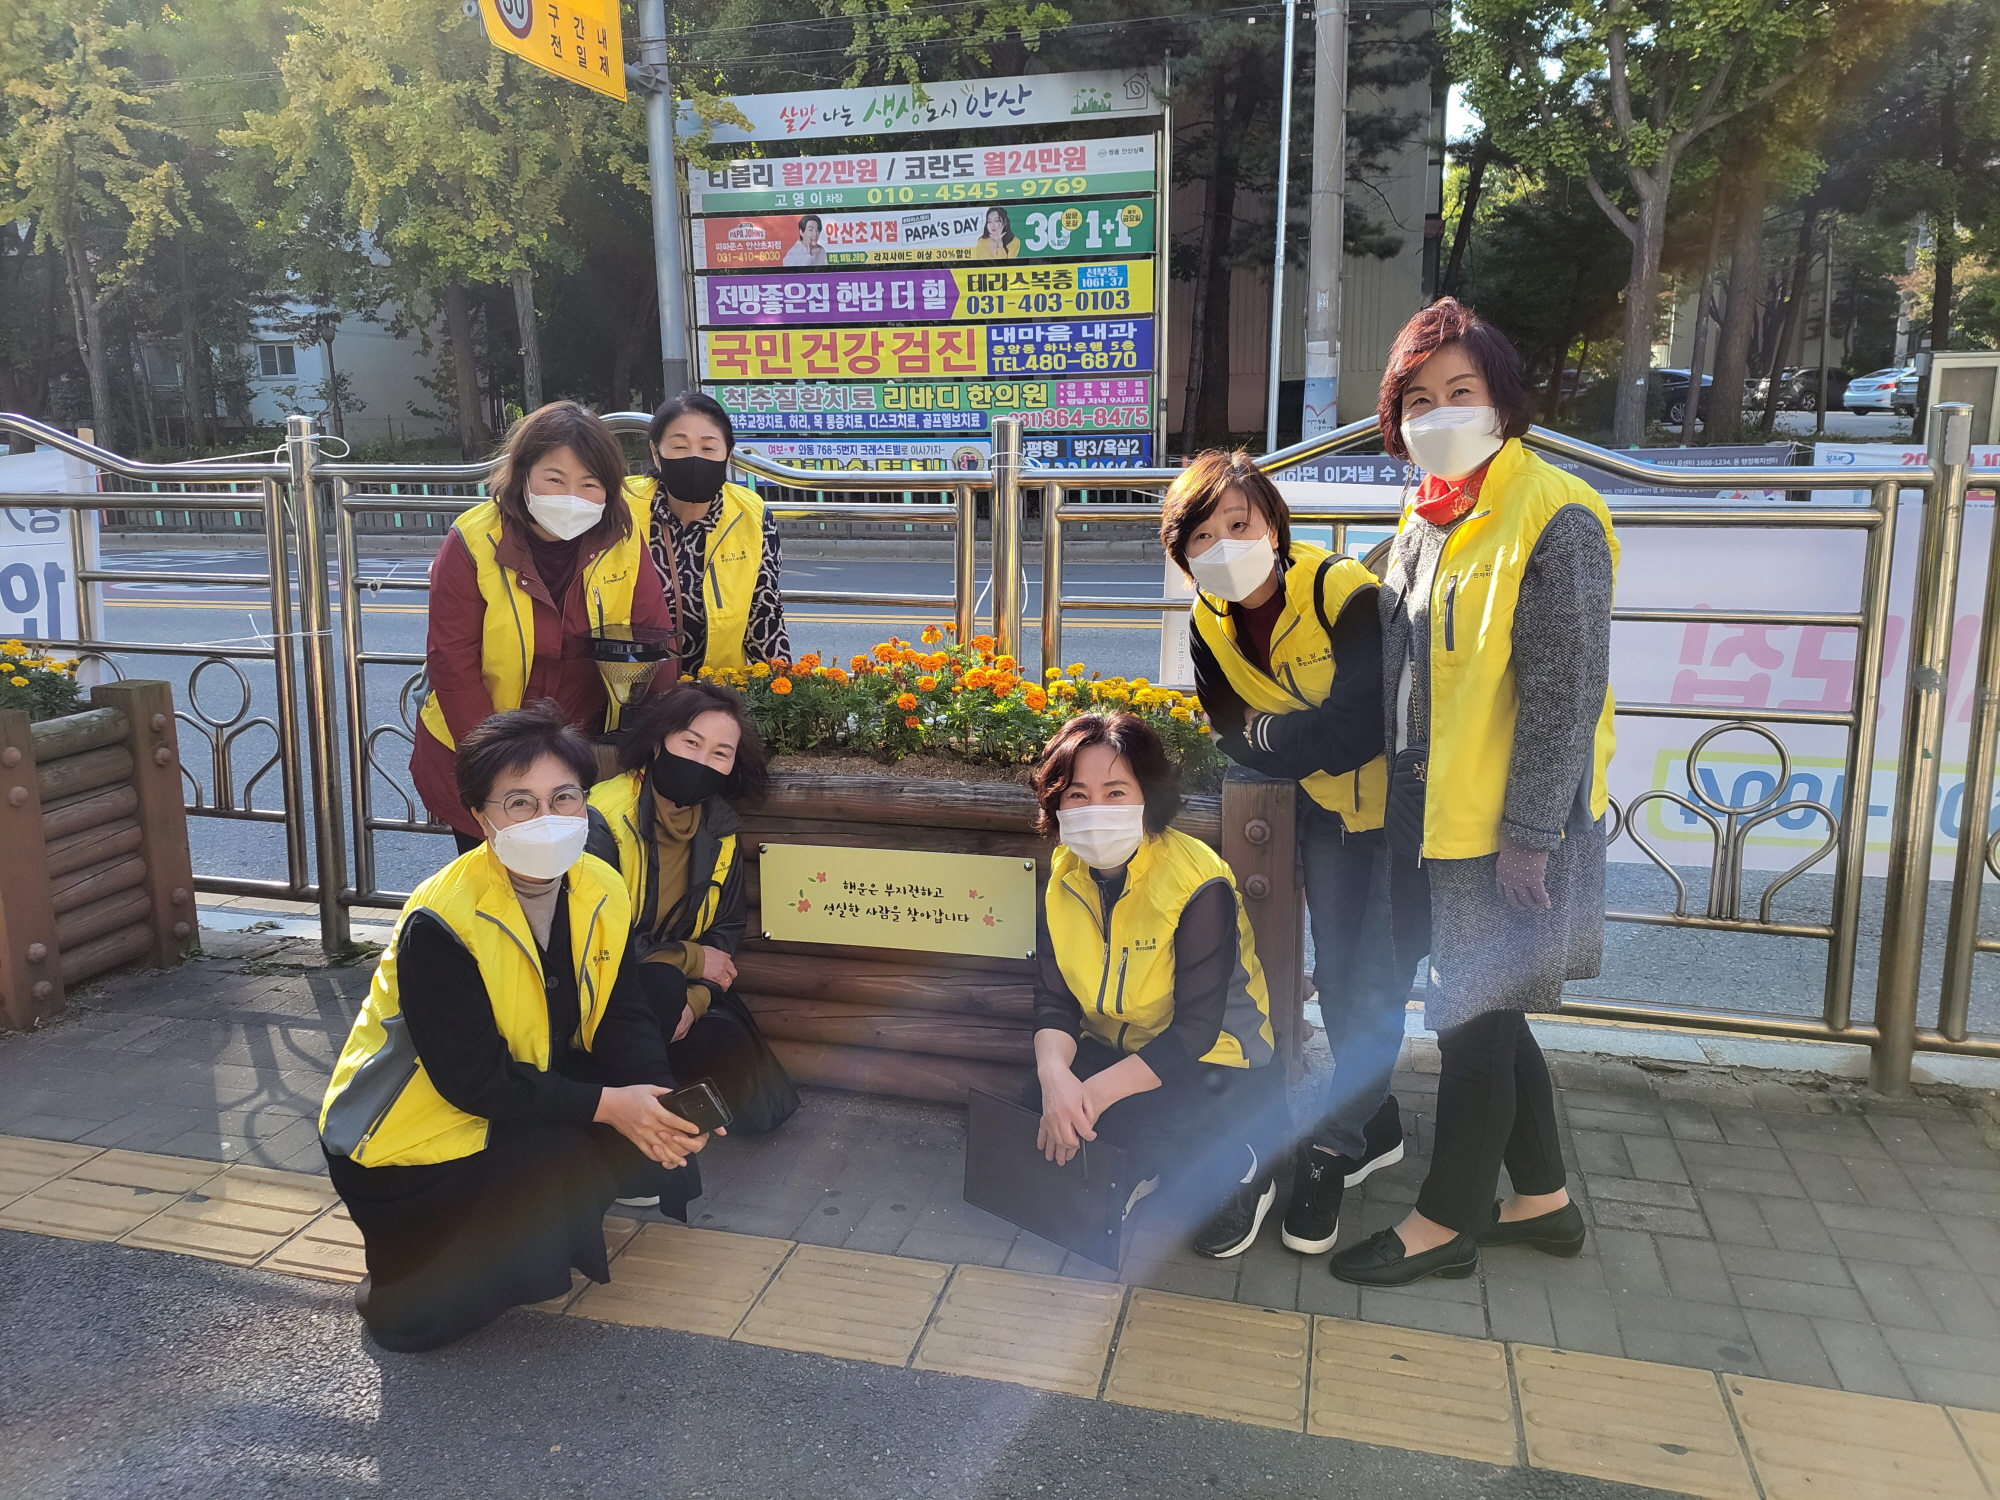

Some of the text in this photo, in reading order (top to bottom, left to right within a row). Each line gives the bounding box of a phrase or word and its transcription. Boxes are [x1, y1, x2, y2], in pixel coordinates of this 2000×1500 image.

[965, 83, 1032, 118] 안산
[782, 158, 878, 187] 월22만원
[904, 153, 975, 180] 코란도
[983, 146, 1087, 177] 월24만원
[825, 220, 898, 245] 안산초지점
[905, 216, 980, 242] PAPA'S DAY
[716, 251, 781, 263] 031-410-8030
[916, 250, 932, 260] 이상
[967, 269, 1073, 292] 테라스복층
[1081, 276, 1124, 288] 1061-37
[715, 279, 947, 315] 전망좋은집 한남 더 힐
[966, 289, 1130, 315] 031-403-0103
[991, 322, 1138, 343] 내마음 내과
[992, 351, 1138, 373] TEL.480-6870
[723, 383, 1049, 412] 척추질환치료 리바디 한의원
[813, 414, 823, 430] 목
[798, 444, 814, 456] 와동
[817, 444, 858, 456] 768-5번지
[1074, 439, 1140, 457] 방3/욕실2
[1324, 465, 1375, 482] 이겨낼
[1380, 465, 1396, 482] 수
[842, 879, 944, 898] 행운은 부지런하고
[823, 901, 970, 925] 성실한 사람을 찾아갑니다
